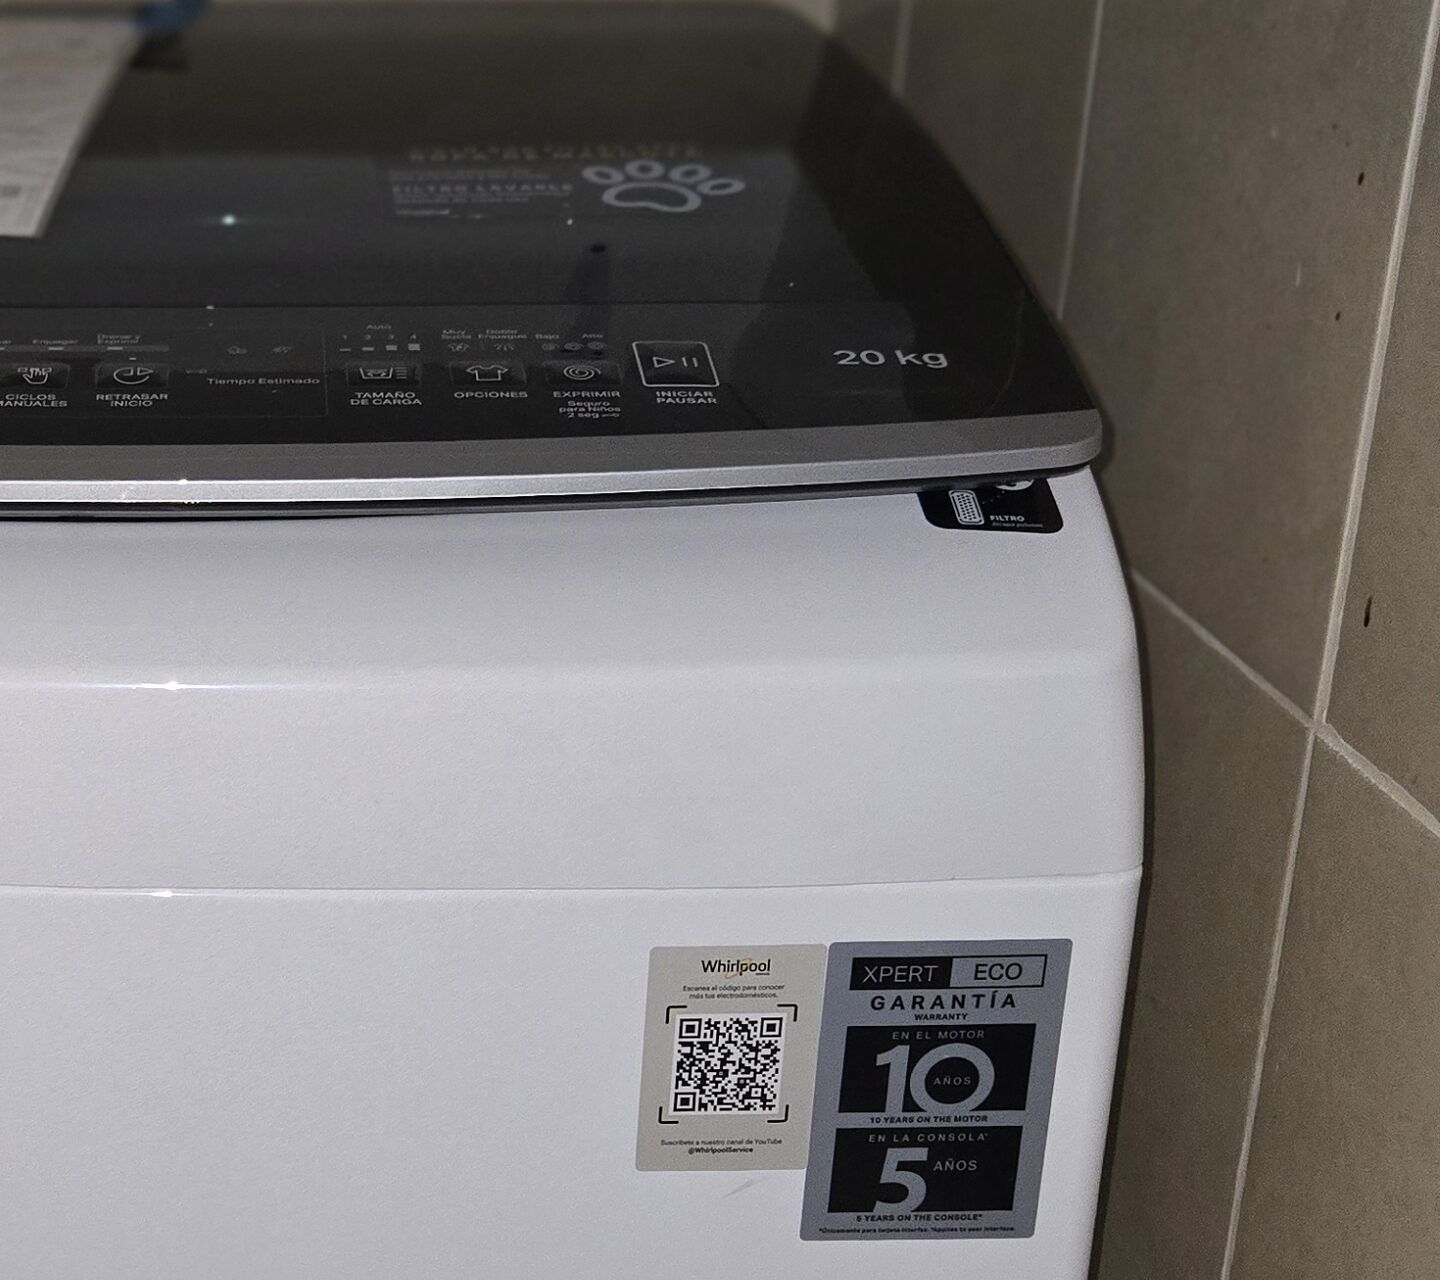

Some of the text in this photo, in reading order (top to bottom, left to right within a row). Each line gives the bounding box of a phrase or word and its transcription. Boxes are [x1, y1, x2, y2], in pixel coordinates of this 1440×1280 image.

[832, 349, 949, 369] 20 kg
[206, 377, 321, 386] Tiempo Estimado
[4, 393, 57, 401] CICLOS
[95, 393, 169, 401] RETRASAR
[354, 390, 416, 399] TAMAÑO
[453, 391, 529, 400] OPCIONES
[552, 390, 622, 398] EXPRIMIR
[655, 390, 714, 398] INICIAR
[110, 400, 154, 408] INICIO
[349, 398, 423, 406] DE CARGA
[566, 400, 610, 408] Seguro
[656, 397, 718, 405] PAUSAR
[989, 514, 1025, 522] FILTRO
[700, 958, 772, 979] Whirlpool
[973, 961, 1023, 981] ECO
[862, 964, 939, 983] XPERT
[869, 989, 1016, 1011] GARANTÍA
[913, 1012, 968, 1021] WARRANTY
[891, 1029, 984, 1040] EN EL MOTOR
[875, 1042, 996, 1114] 10
[932, 1075, 971, 1085] AÑOS
[869, 1114, 988, 1124] 10 YEARS ON THE MOTOR
[868, 1133, 886, 1143] EN
[892, 1133, 910, 1142] LA
[687, 1146, 754, 1155] @WhirlpoolService
[932, 1158, 977, 1171] AÑOS
[872, 1146, 928, 1214] 5
[855, 1214, 862, 1222] 5
[863, 1213, 895, 1222] YEARS
[896, 1213, 911, 1221] ON
[912, 1213, 931, 1221] THE
